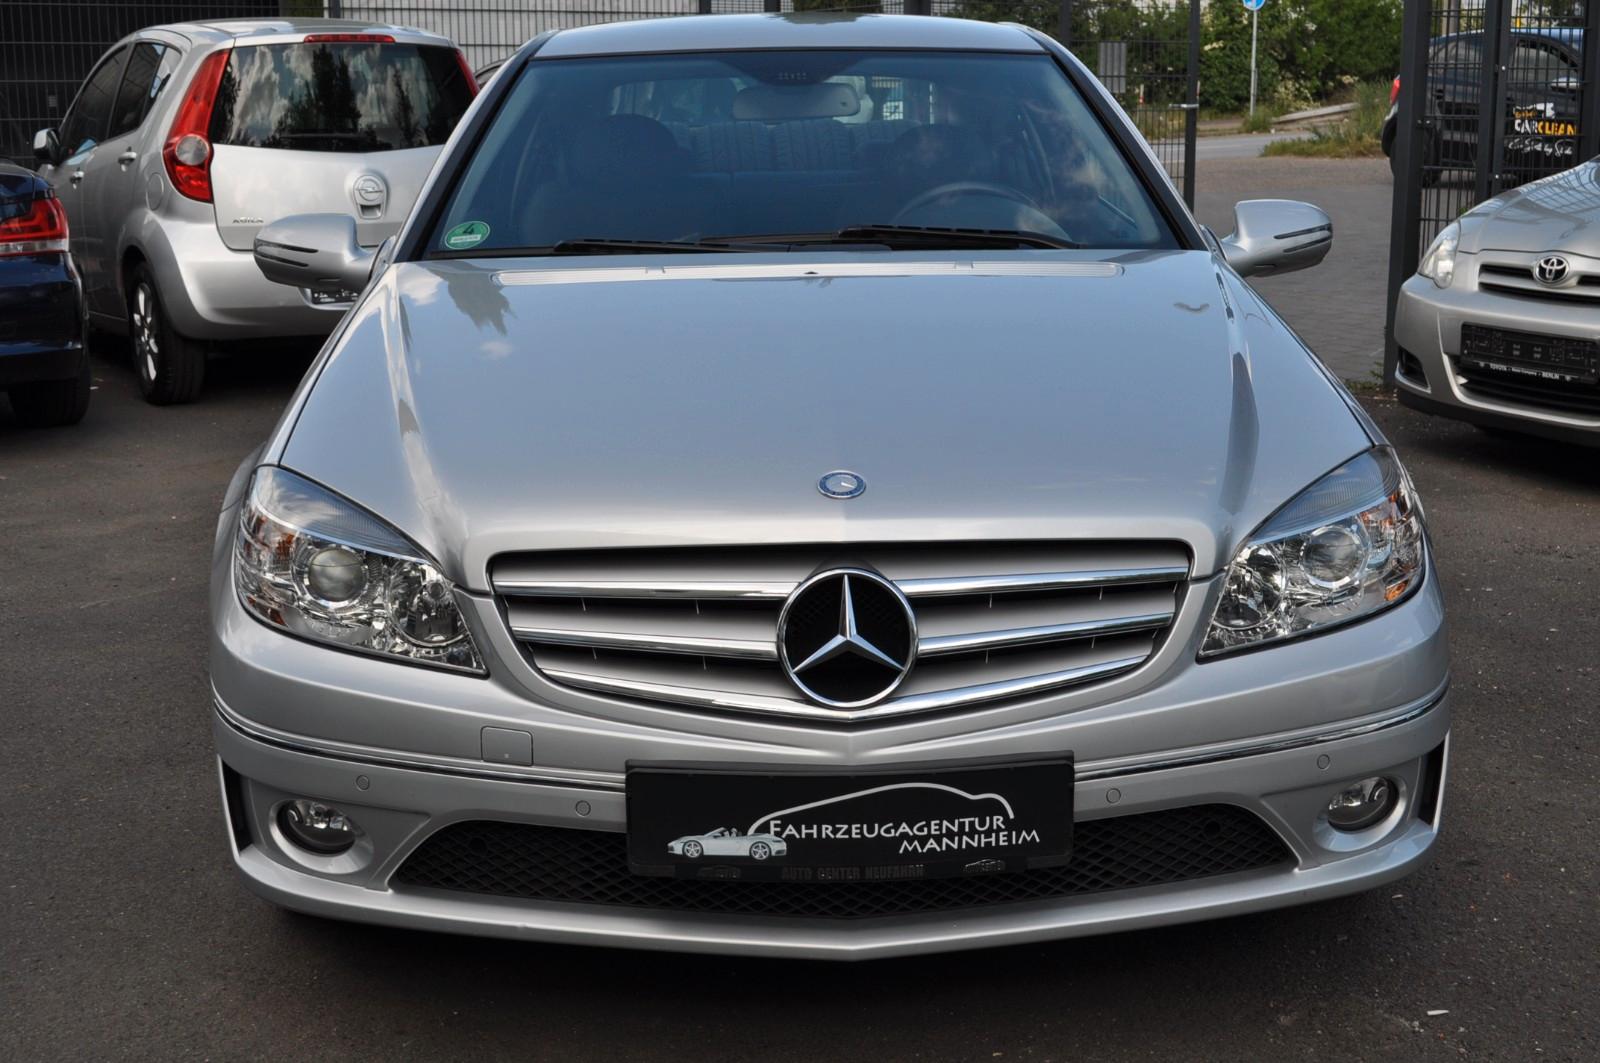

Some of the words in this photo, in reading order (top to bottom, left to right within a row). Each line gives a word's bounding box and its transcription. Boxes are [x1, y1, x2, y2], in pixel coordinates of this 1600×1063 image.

[462, 223, 475, 235] 4
[768, 814, 1007, 840] FAHRZEUGAGENTUR
[898, 828, 1041, 854] MANNHEIM
